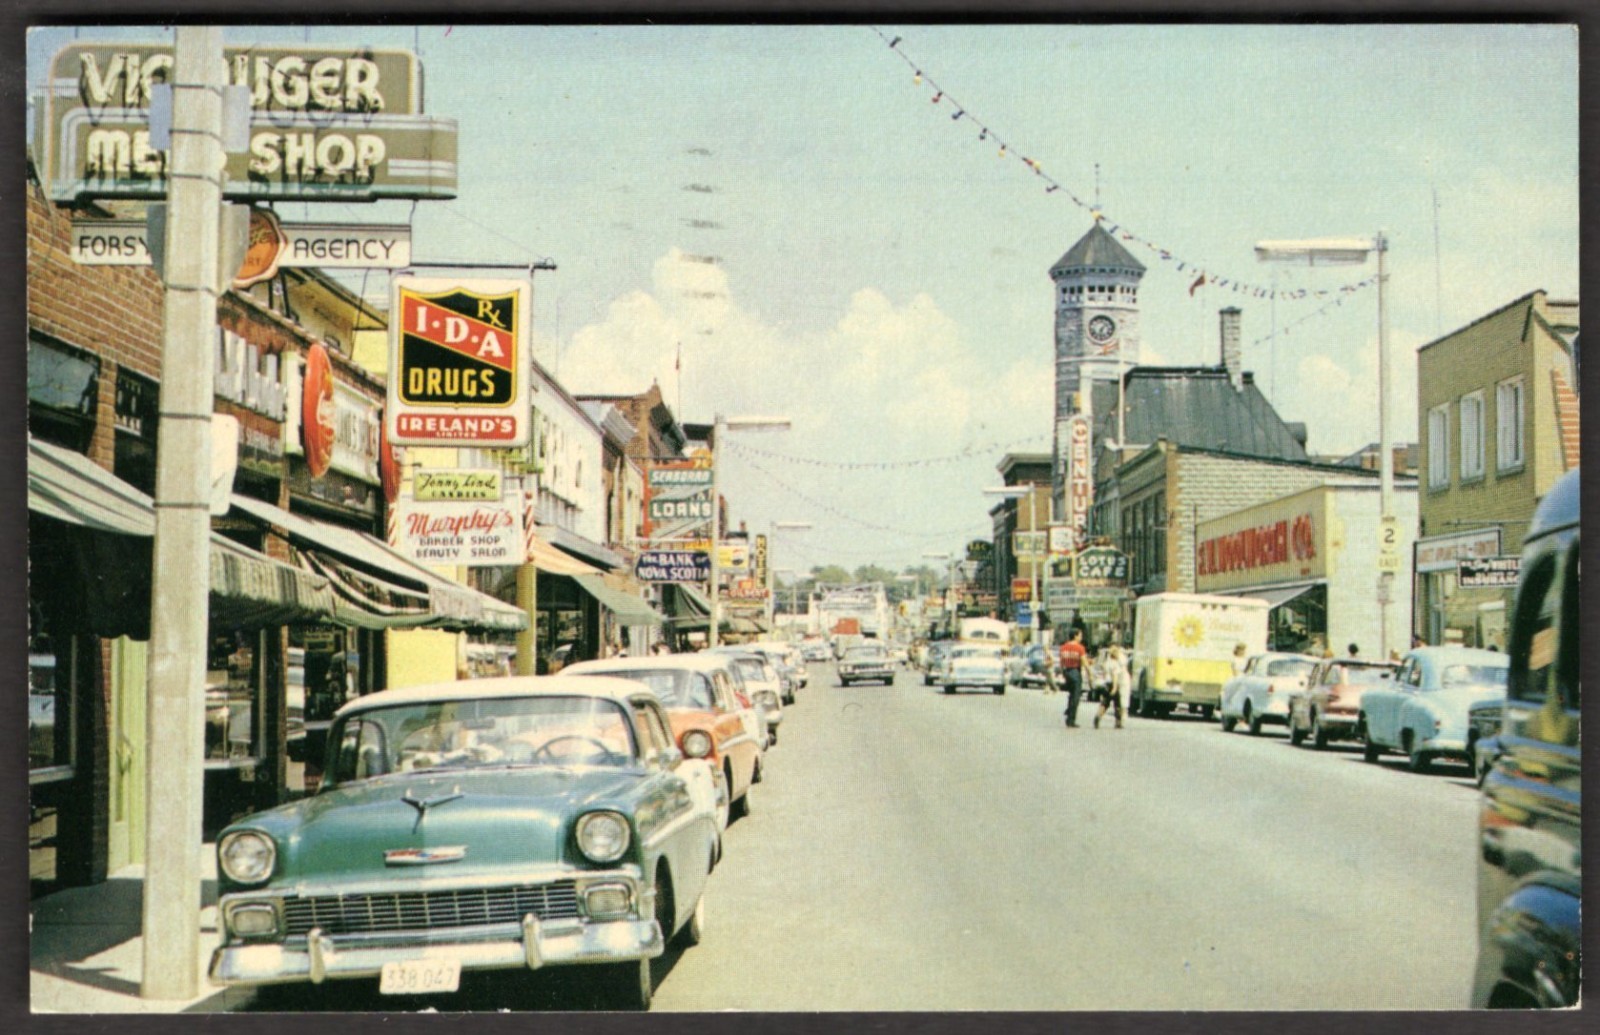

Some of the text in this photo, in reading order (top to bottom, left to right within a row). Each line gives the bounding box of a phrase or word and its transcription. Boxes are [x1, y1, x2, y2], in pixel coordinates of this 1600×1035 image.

[249, 132, 386, 176] SHOP
[293, 236, 397, 258] AGENCY
[409, 367, 495, 398] DRUGS
[400, 416, 513, 433] IRELAND'S
[653, 502, 712, 518] LOANS
[406, 509, 513, 536] Murphy's
[470, 536, 501, 545] SHOP
[1384, 528, 1394, 543] 2
[416, 547, 506, 558] BEAUTY SALON
[658, 553, 694, 566] BANK
[1080, 555, 1126, 567] LOTUS
[638, 567, 709, 579] NOVA SCOTIA
[1080, 567, 1125, 577] CAFE
